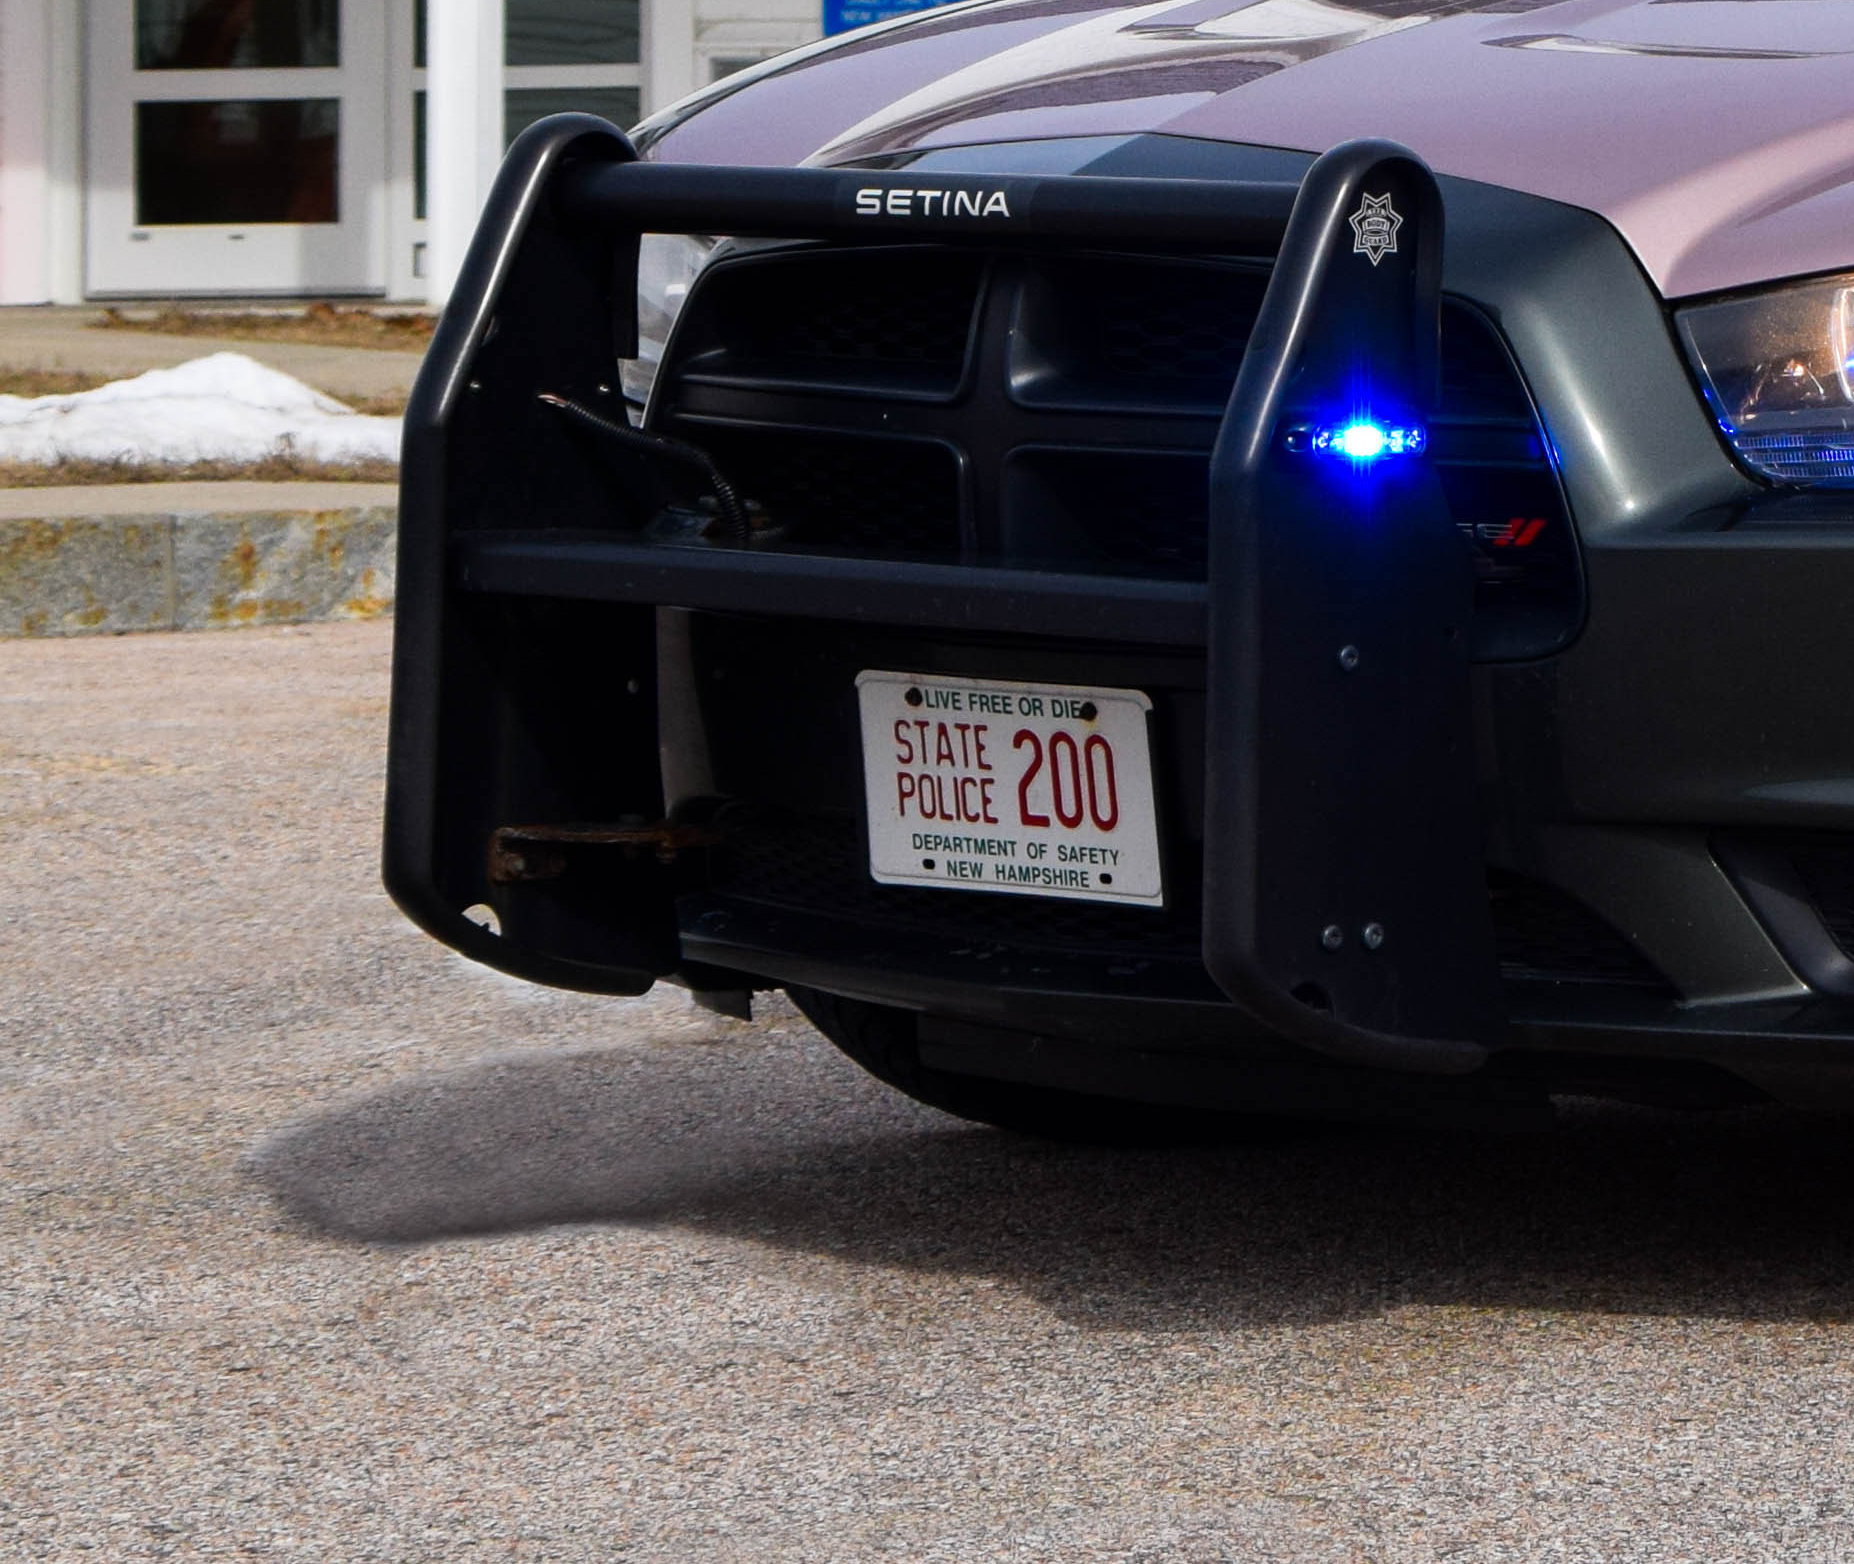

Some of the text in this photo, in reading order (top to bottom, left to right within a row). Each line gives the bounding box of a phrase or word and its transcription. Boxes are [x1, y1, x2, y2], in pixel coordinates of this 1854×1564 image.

[856, 189, 1010, 217] SETINA
[925, 689, 1082, 720] LIVE FREE OR DIE
[894, 720, 992, 770] STATE
[1013, 729, 1119, 832] 200
[897, 772, 999, 824] POLICE
[912, 833, 1119, 866] DEPARTMENT OF SAFETY
[946, 861, 1090, 888] NEW HAMPSHIRE
